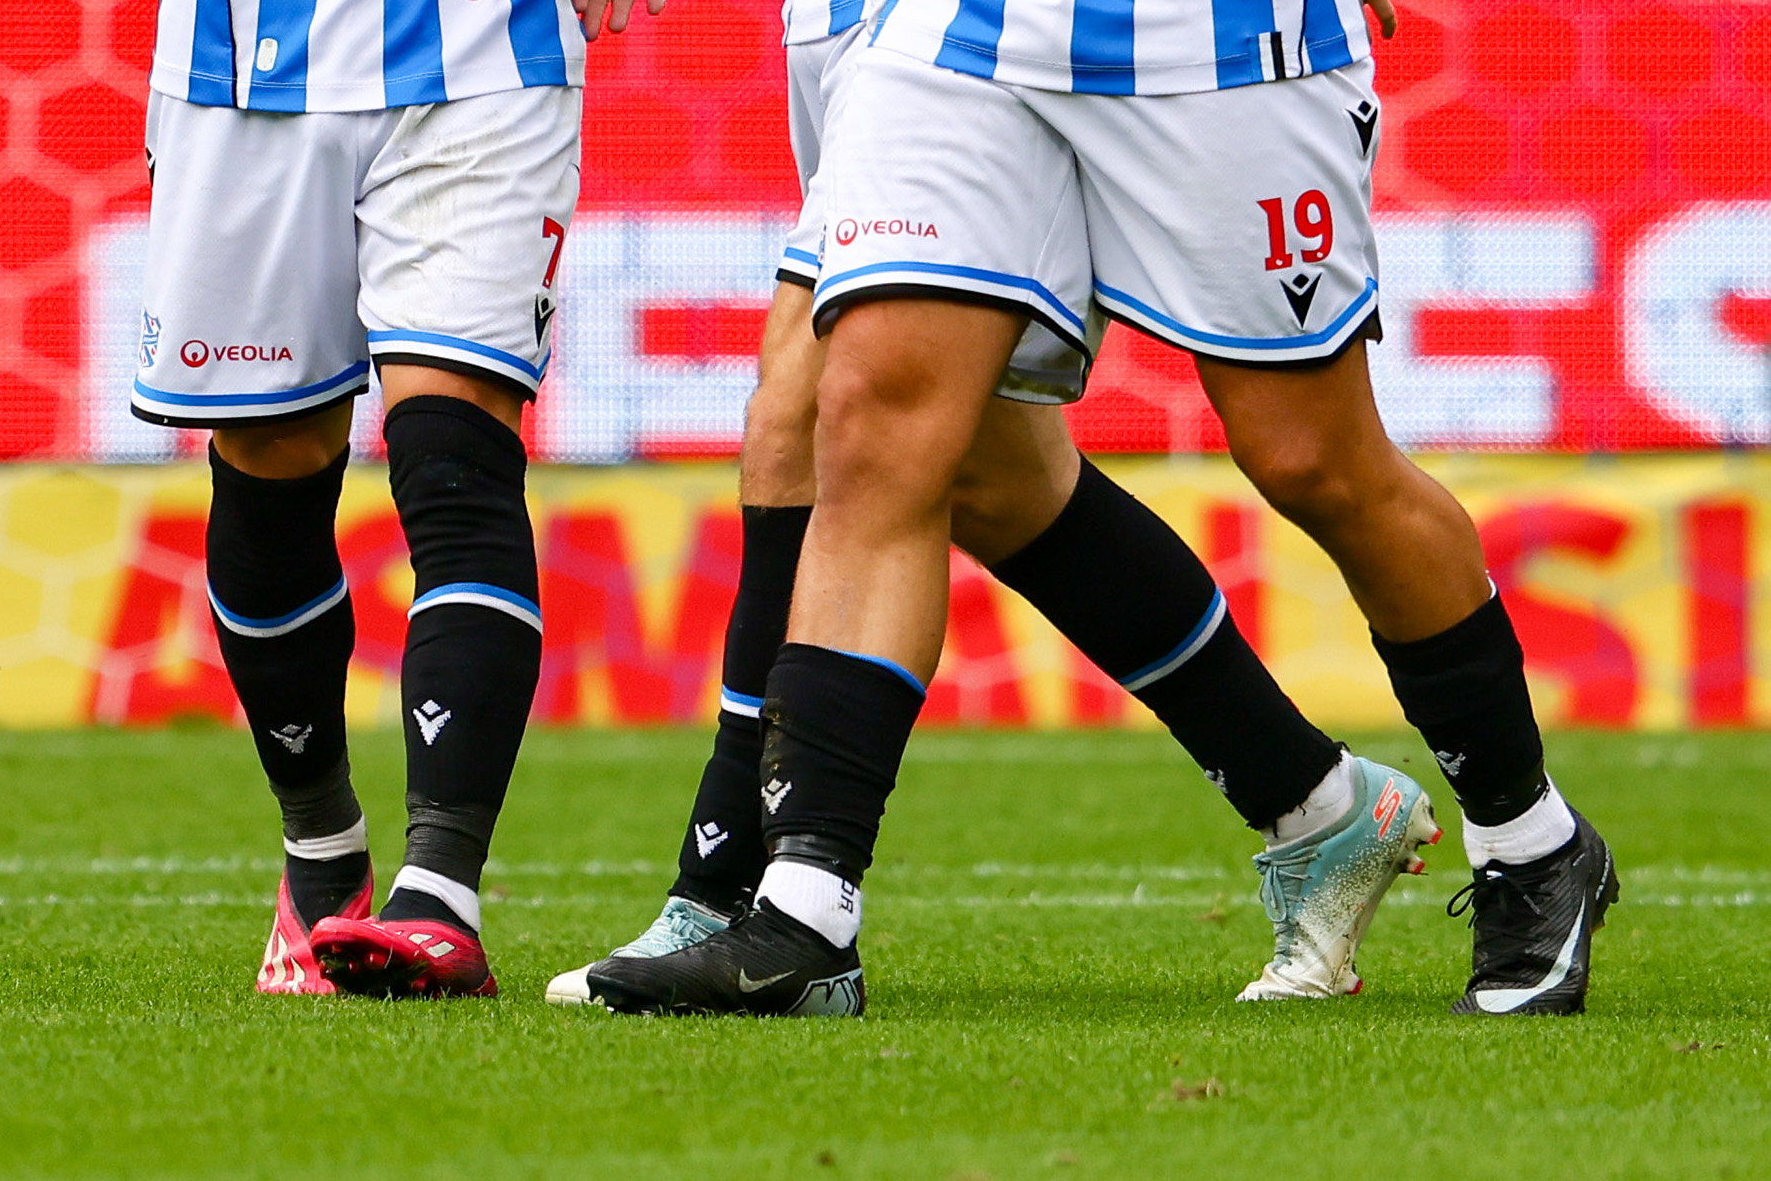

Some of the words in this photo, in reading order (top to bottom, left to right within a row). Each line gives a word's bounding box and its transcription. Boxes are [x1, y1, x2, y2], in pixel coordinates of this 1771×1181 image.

[541, 215, 565, 290] 7
[861, 219, 939, 239] VEOLIA
[1255, 189, 1333, 271] 19
[213, 345, 293, 362] VEOLIA
